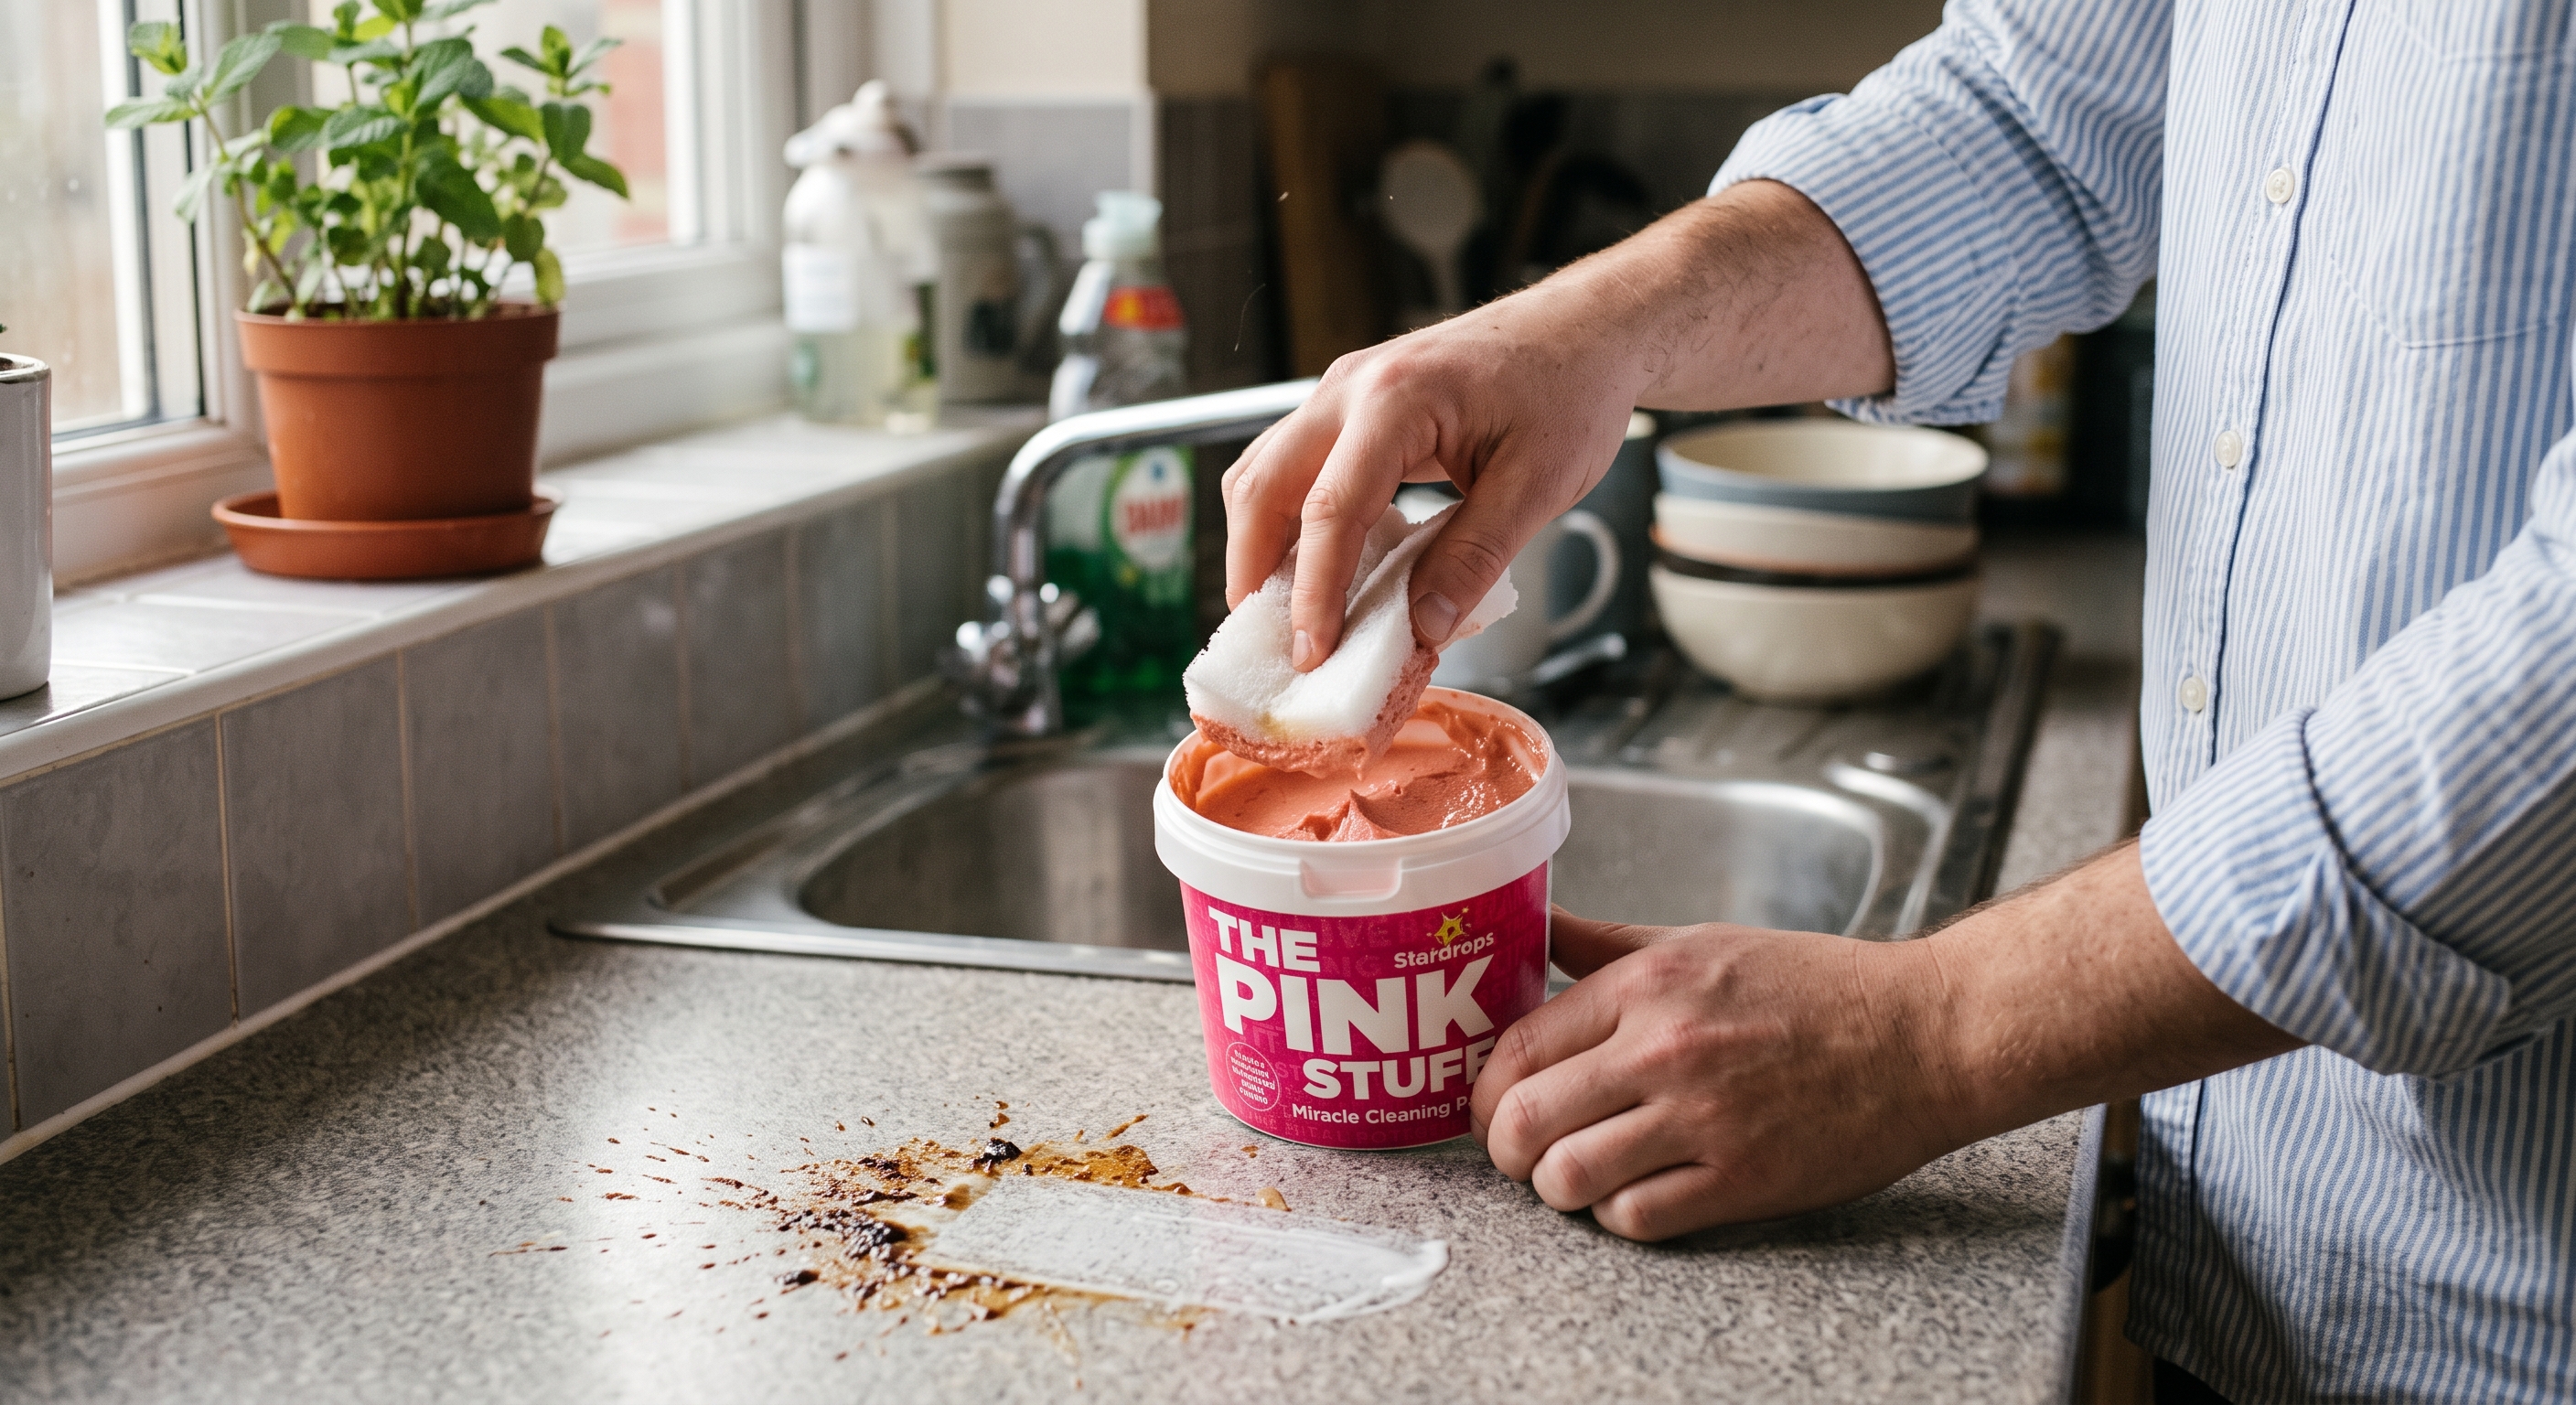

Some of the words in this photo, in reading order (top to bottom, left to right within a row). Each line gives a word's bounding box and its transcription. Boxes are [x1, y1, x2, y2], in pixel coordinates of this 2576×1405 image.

[1208, 905, 1321, 973] THE
[1393, 932, 1495, 970] Stardrops
[1215, 952, 1495, 1056] PINK
[1302, 1035, 1496, 1100] STUFF
[1292, 1103, 1360, 1124] Miracle
[1365, 1103, 1451, 1124] Cleaning
[1456, 1096, 1471, 1111] P
